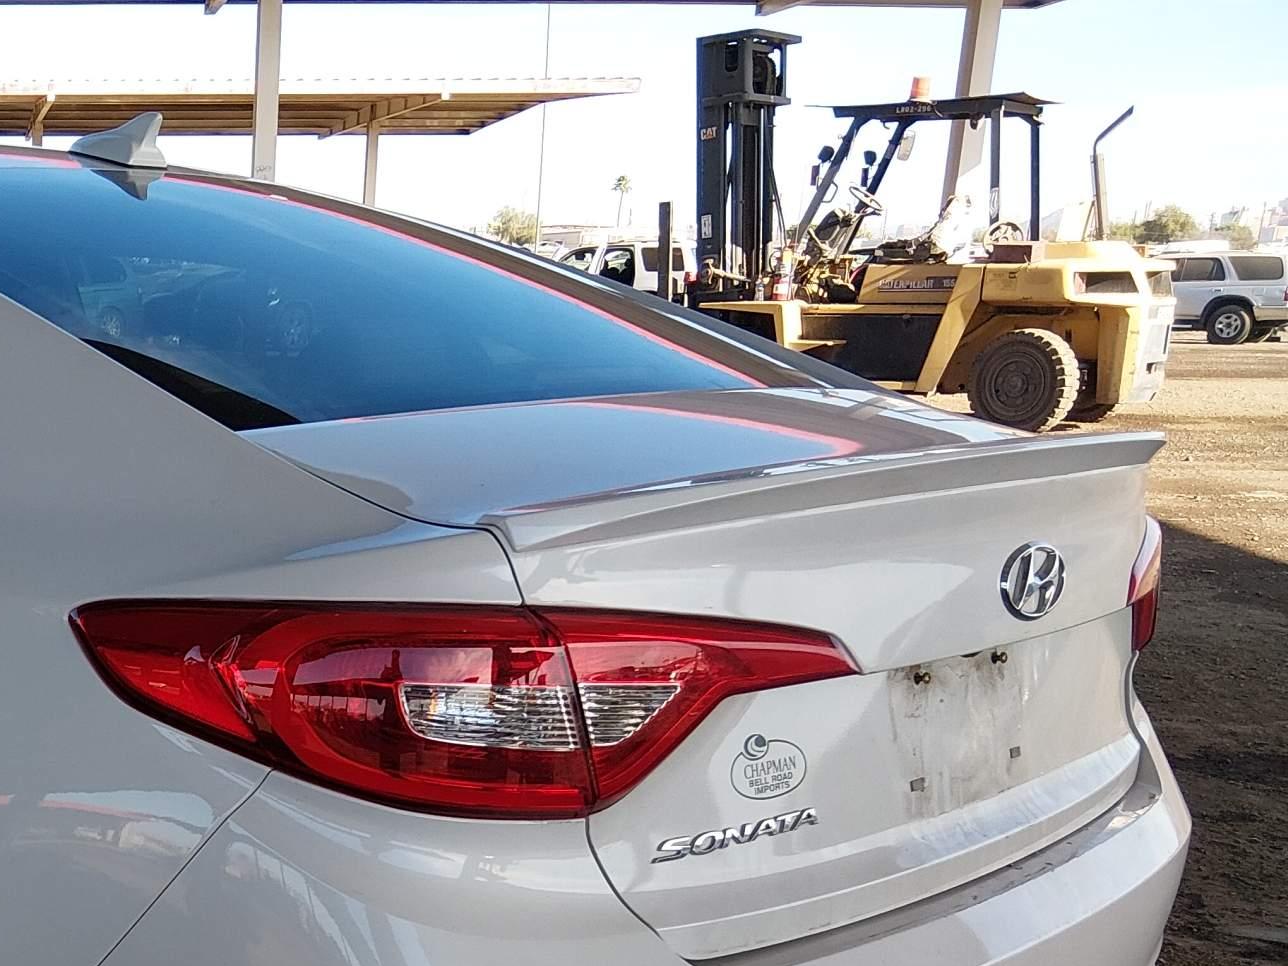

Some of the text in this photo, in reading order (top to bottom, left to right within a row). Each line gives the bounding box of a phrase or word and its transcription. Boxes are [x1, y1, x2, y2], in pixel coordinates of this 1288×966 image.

[700, 126, 718, 141] CAT
[743, 755, 797, 780] CHAPMAN
[748, 771, 794, 788] BELL ROAD
[754, 780, 791, 796] IMPORTS
[649, 807, 819, 864] SONATA
